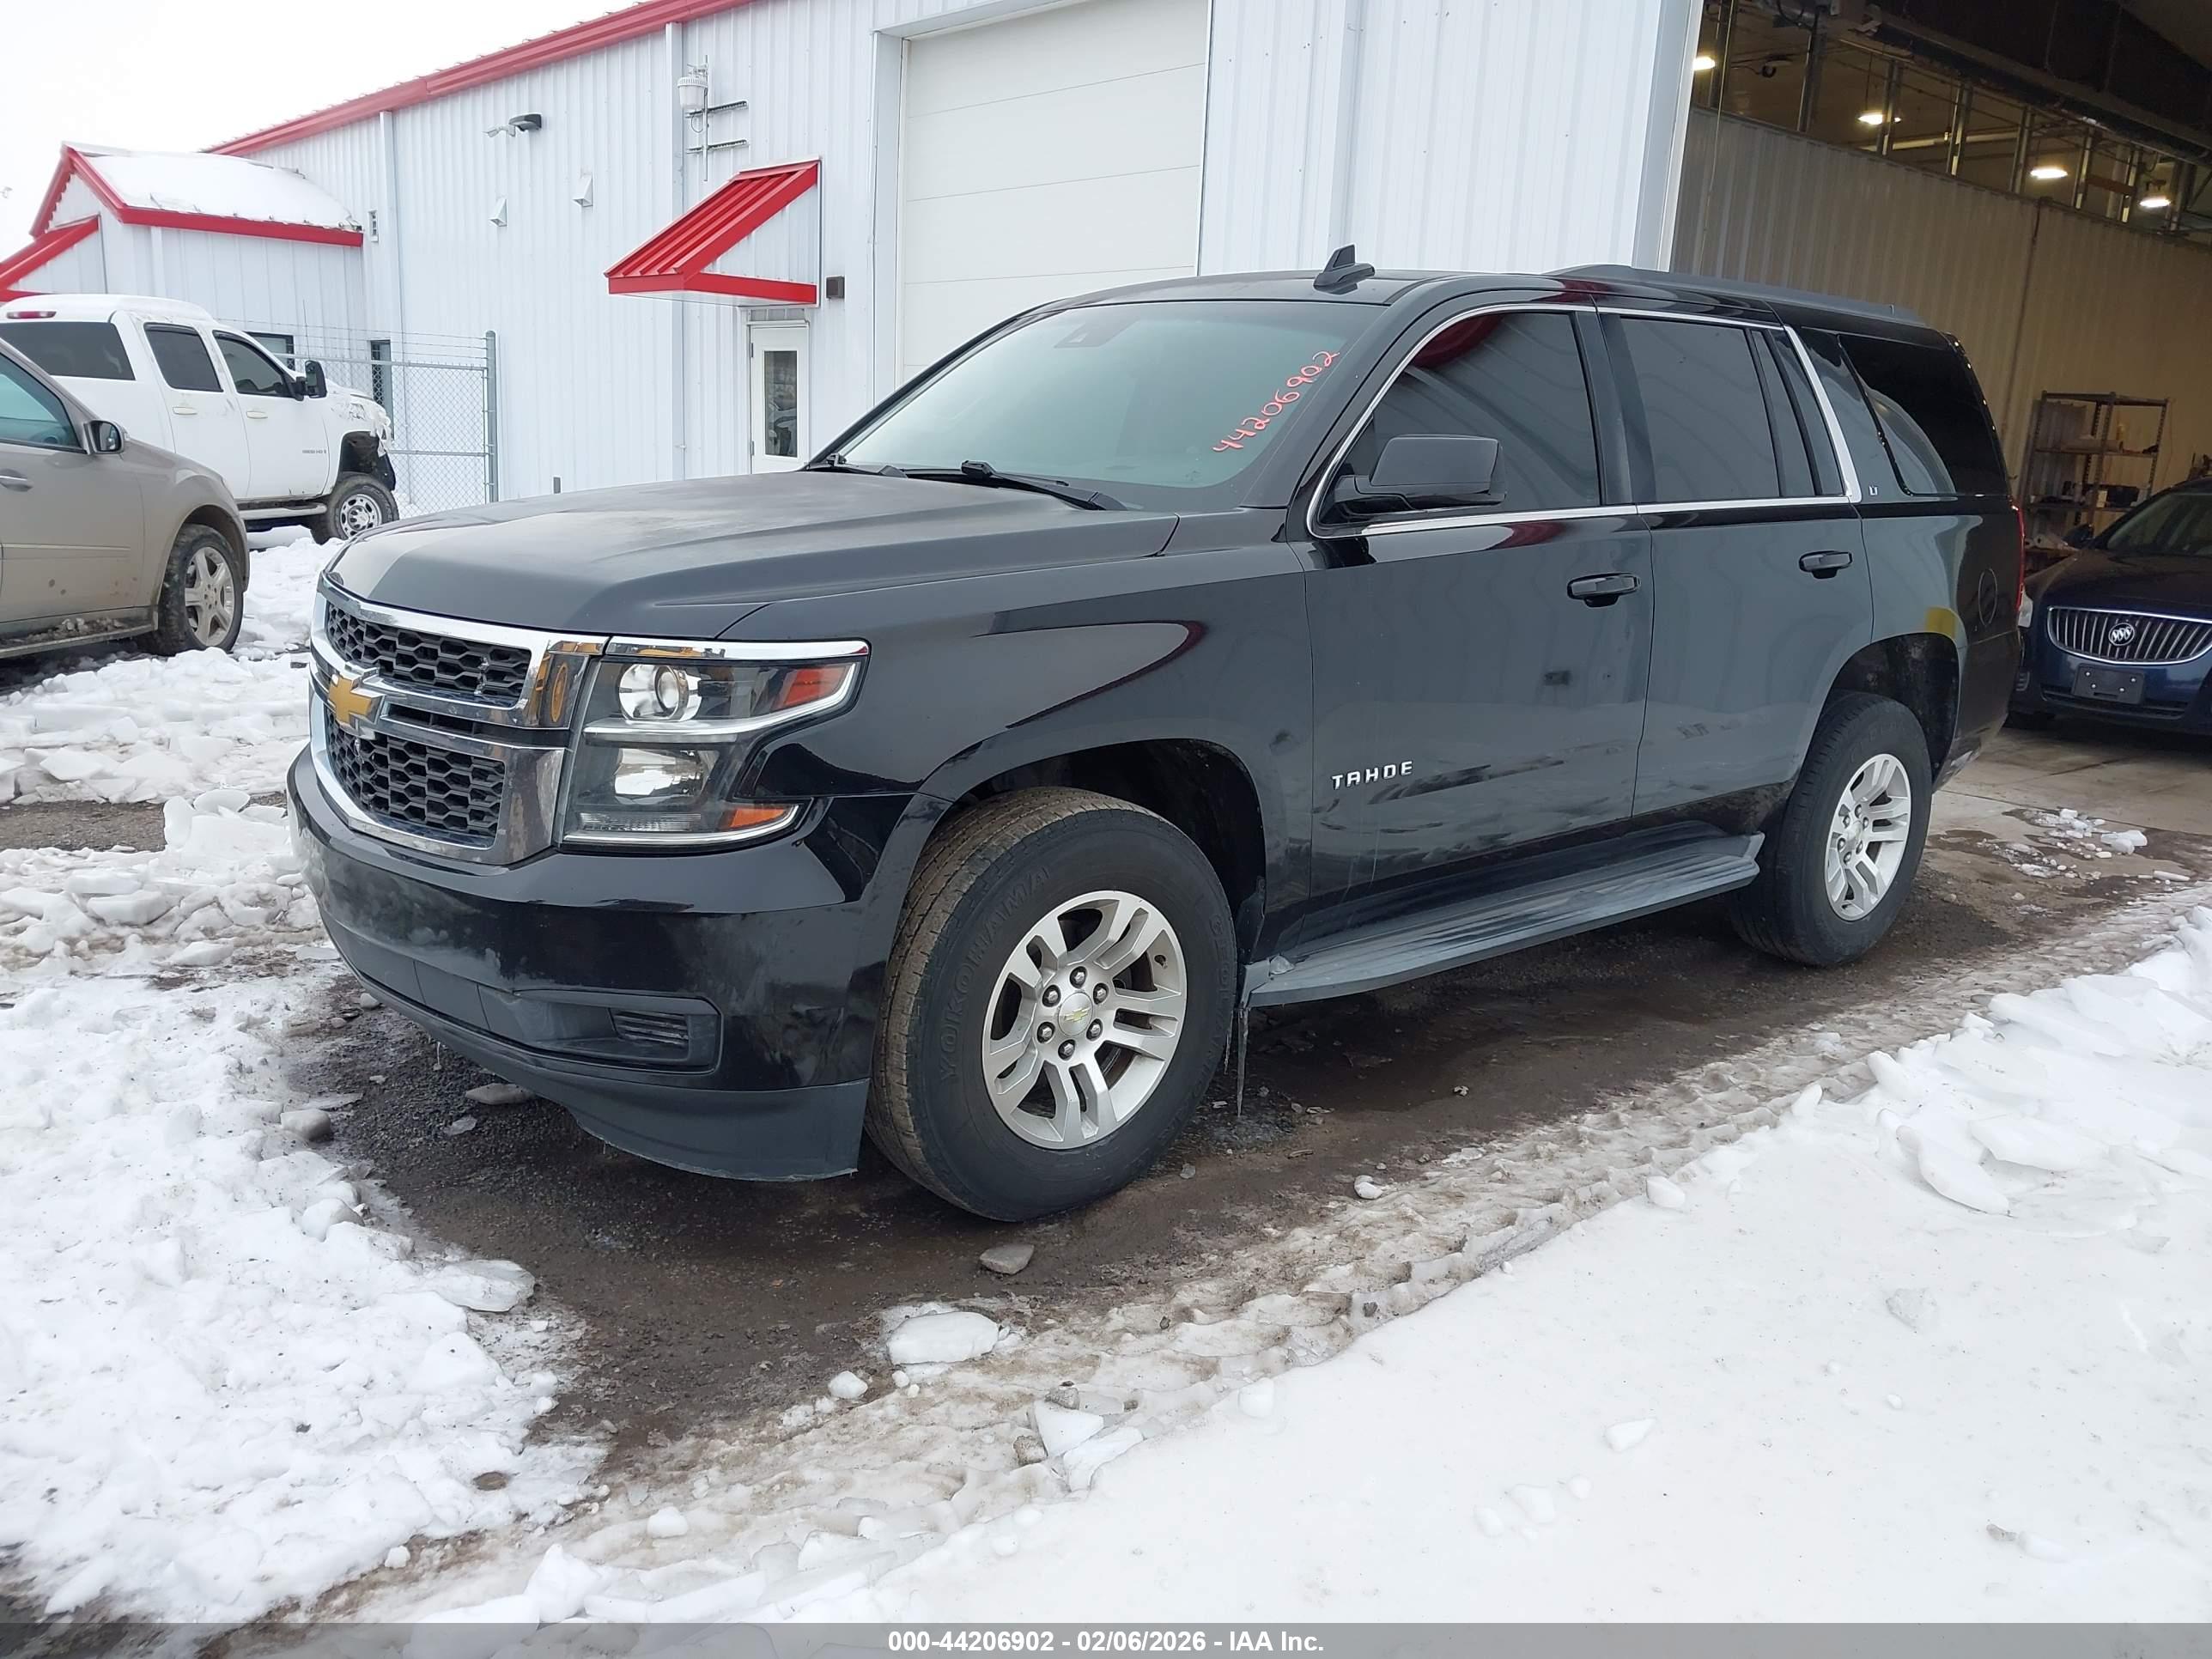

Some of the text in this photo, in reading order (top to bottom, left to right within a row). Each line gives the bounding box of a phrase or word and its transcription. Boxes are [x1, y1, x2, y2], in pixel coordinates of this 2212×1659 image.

[1212, 350, 1340, 452] 44206902
[1331, 760, 1413, 791] TAHOE
[939, 866, 1050, 1082] YOKOHAMA
